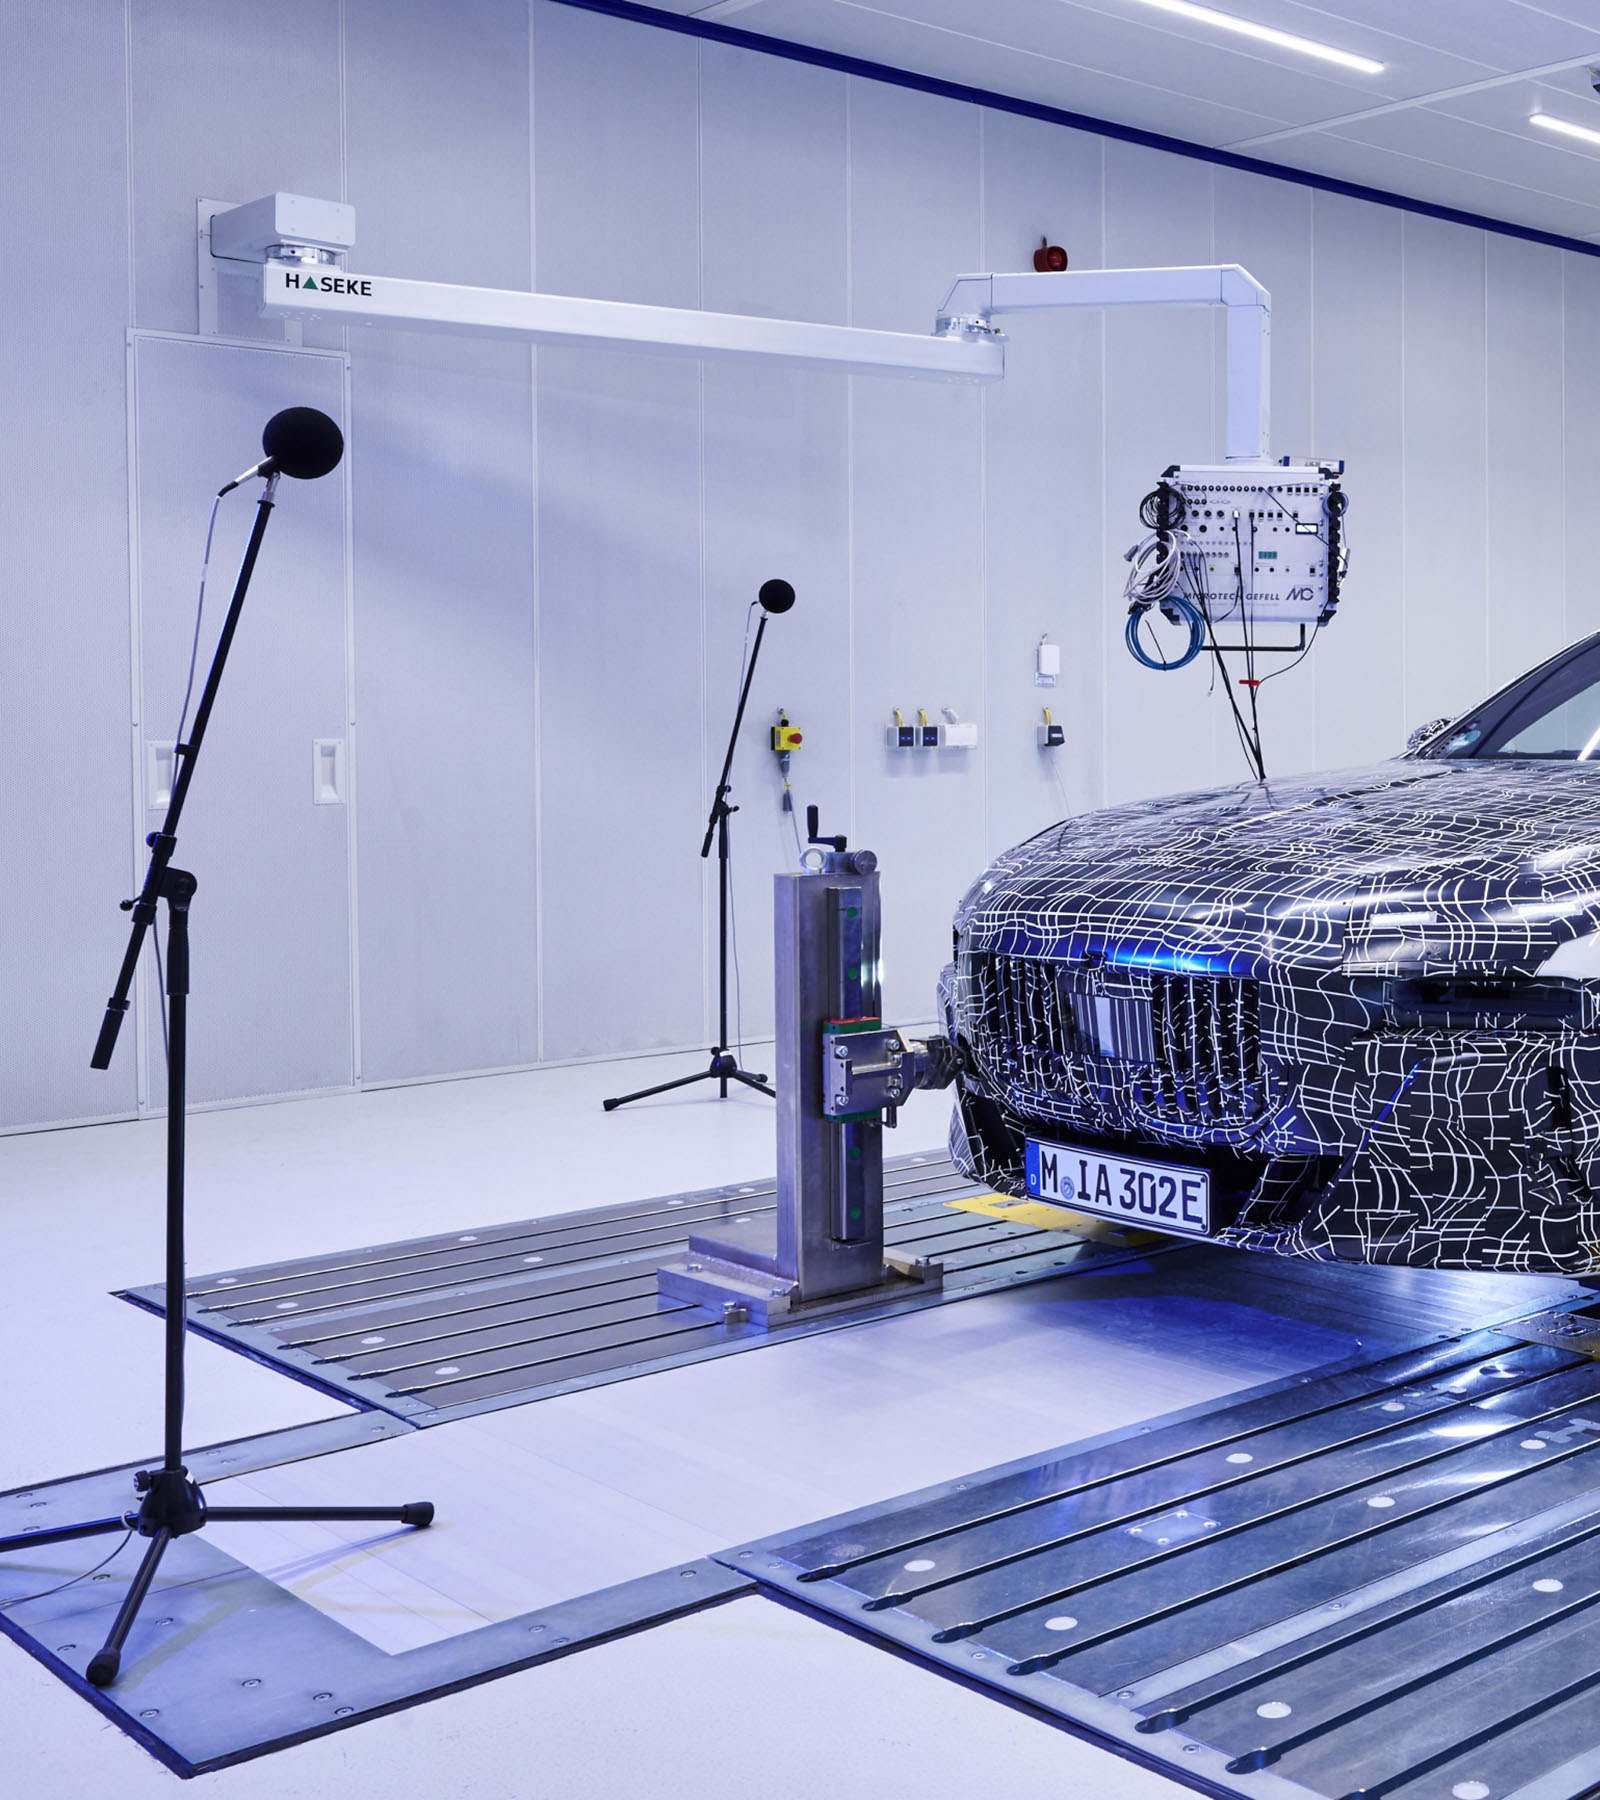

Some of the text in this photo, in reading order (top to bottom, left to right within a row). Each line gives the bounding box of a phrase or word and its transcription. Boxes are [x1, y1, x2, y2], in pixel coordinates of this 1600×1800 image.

[1183, 592, 1243, 601] MIROTEC
[1030, 1173, 1037, 1186] D
[1041, 1150, 1059, 1193] M
[1119, 1168, 1204, 1225] 302E
